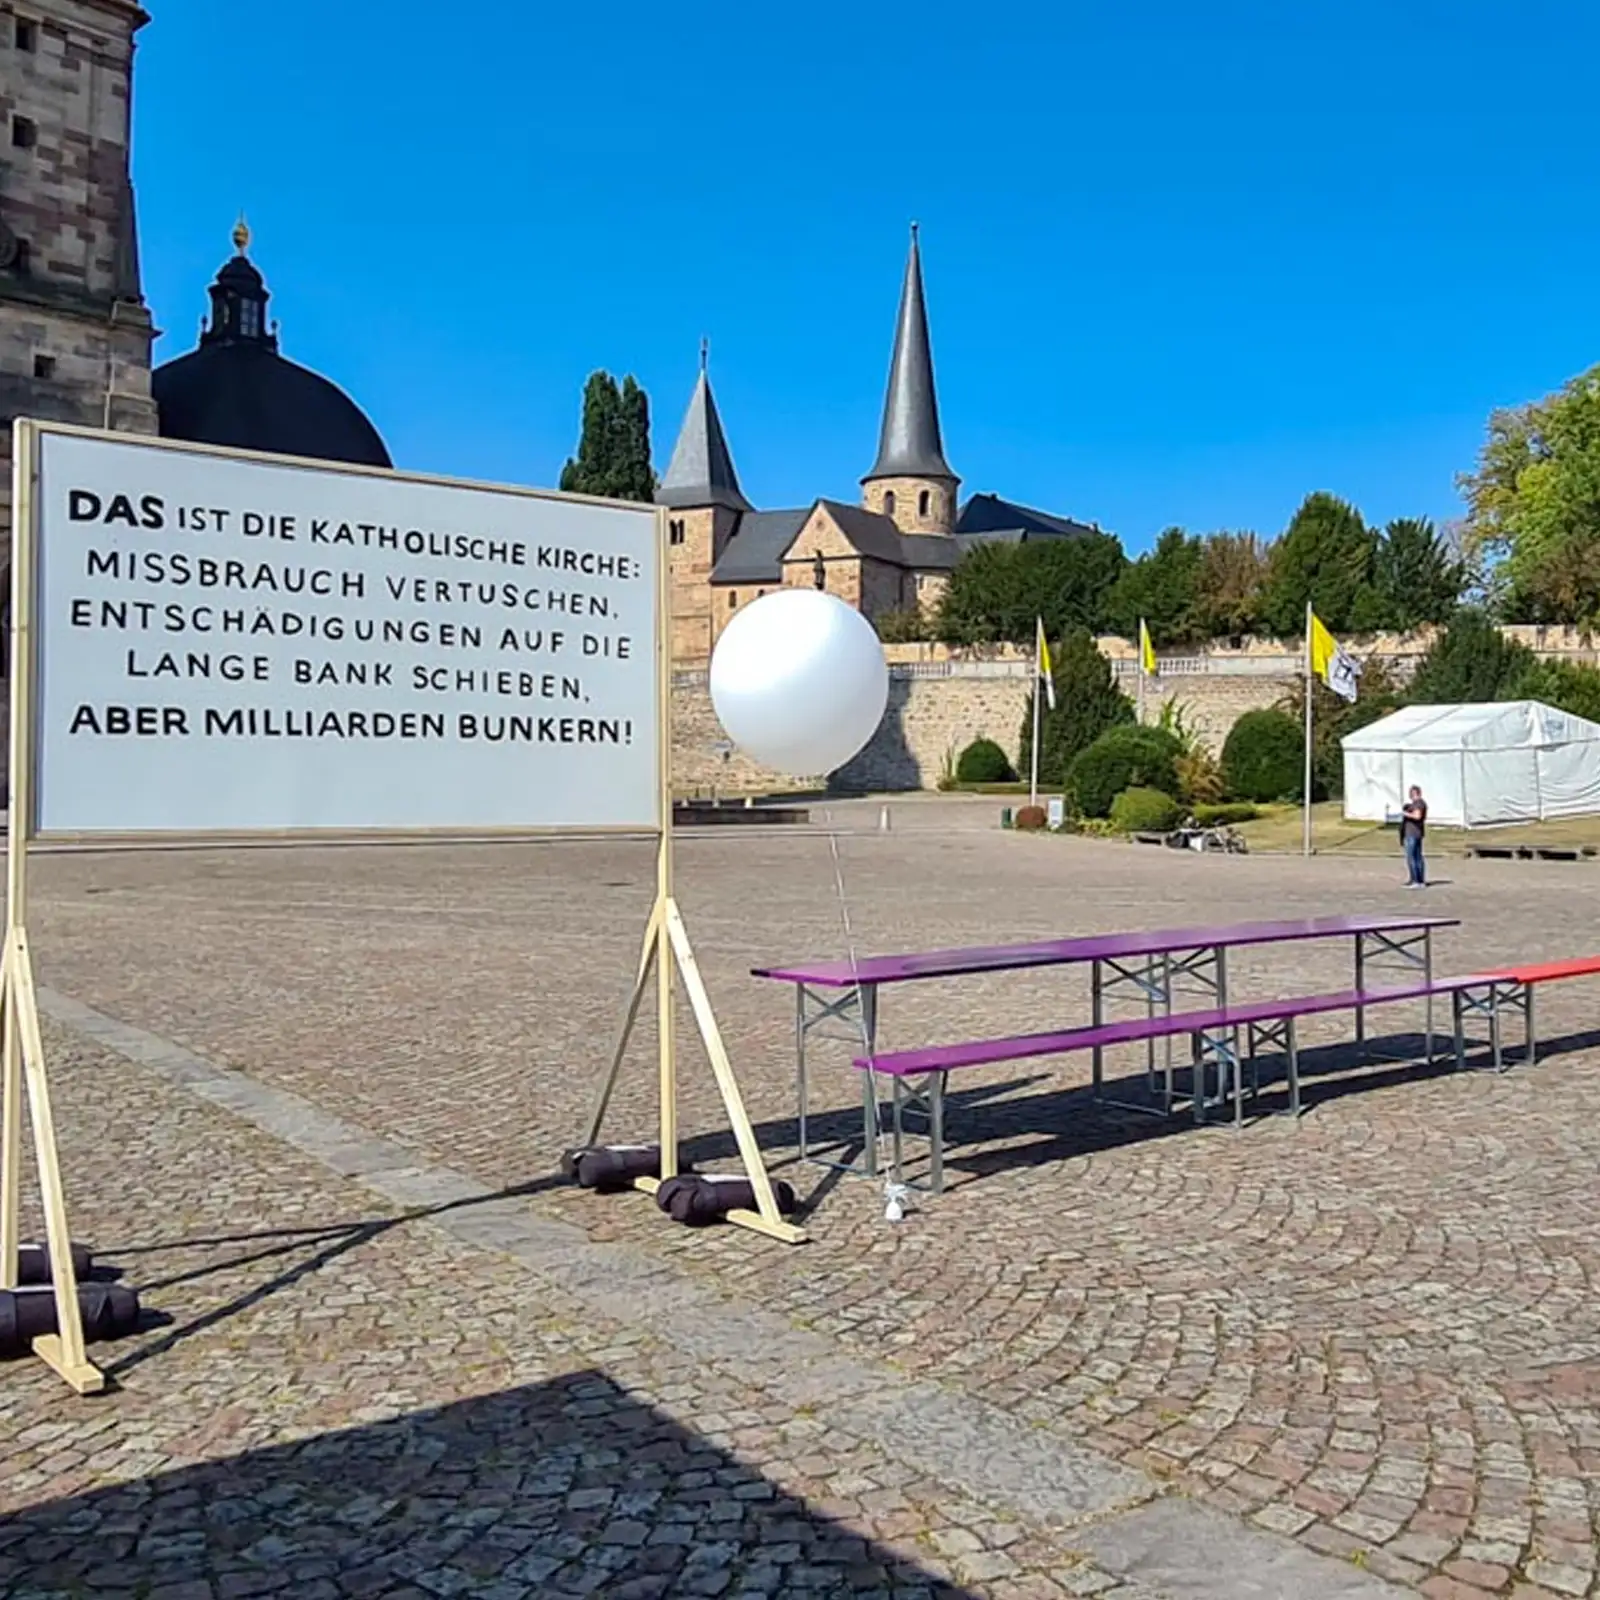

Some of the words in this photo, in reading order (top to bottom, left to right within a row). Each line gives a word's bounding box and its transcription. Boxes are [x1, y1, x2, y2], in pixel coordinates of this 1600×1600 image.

[68, 489, 165, 530] DAS
[178, 506, 231, 533] IST
[242, 512, 296, 541] DIE
[310, 519, 526, 566] KATHOLISCHE
[537, 545, 640, 580] KIRCHE:
[87, 549, 364, 598] MISSBRAUCH
[71, 599, 481, 648] ENTSCHÄDIGUNGEN
[499, 628, 564, 653] AUF
[582, 634, 631, 659] DIE
[127, 648, 269, 681] LANGE
[294, 659, 392, 686] BANK
[69, 704, 190, 736] ABER
[205, 708, 445, 738] MILLIARDEN
[458, 713, 632, 745] BUNKERN!
